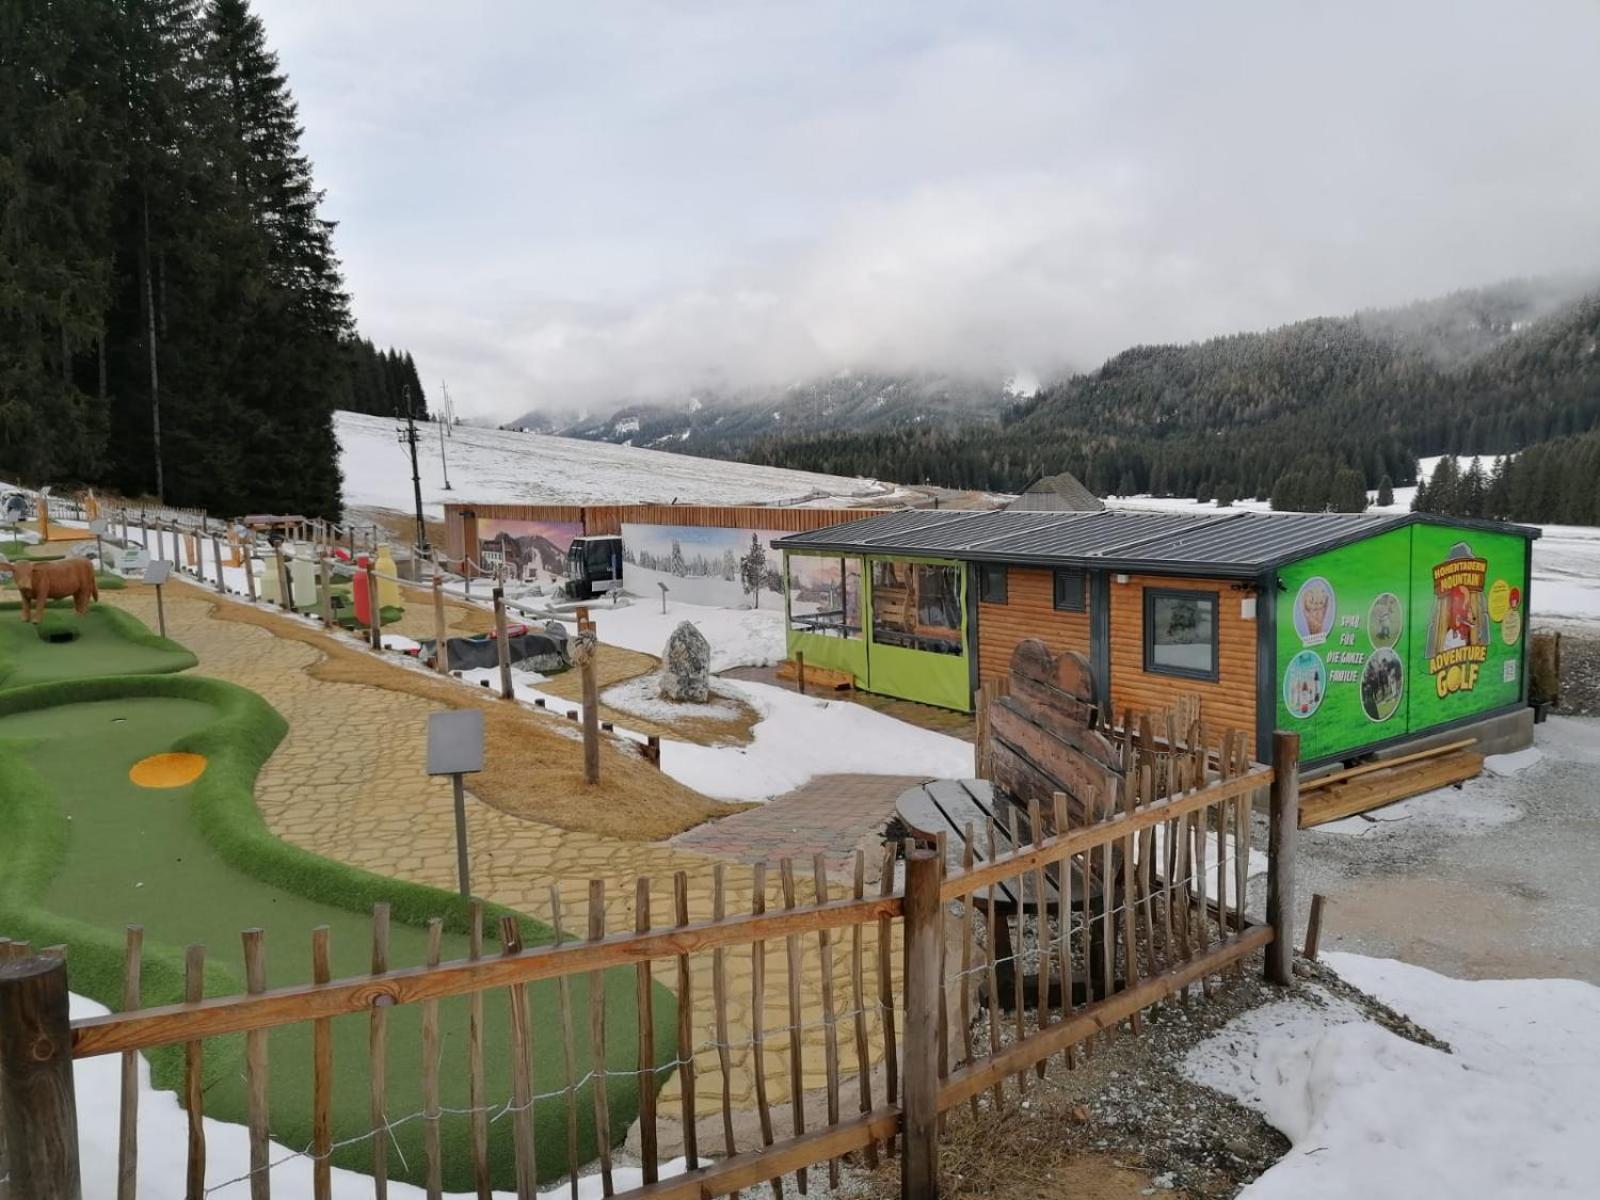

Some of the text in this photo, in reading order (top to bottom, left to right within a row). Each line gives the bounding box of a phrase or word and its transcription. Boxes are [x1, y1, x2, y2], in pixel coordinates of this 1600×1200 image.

[1440, 573, 1480, 592] MOUNTAIN
[1430, 645, 1487, 673] ADVENTURE
[1437, 664, 1479, 698] GOLF
